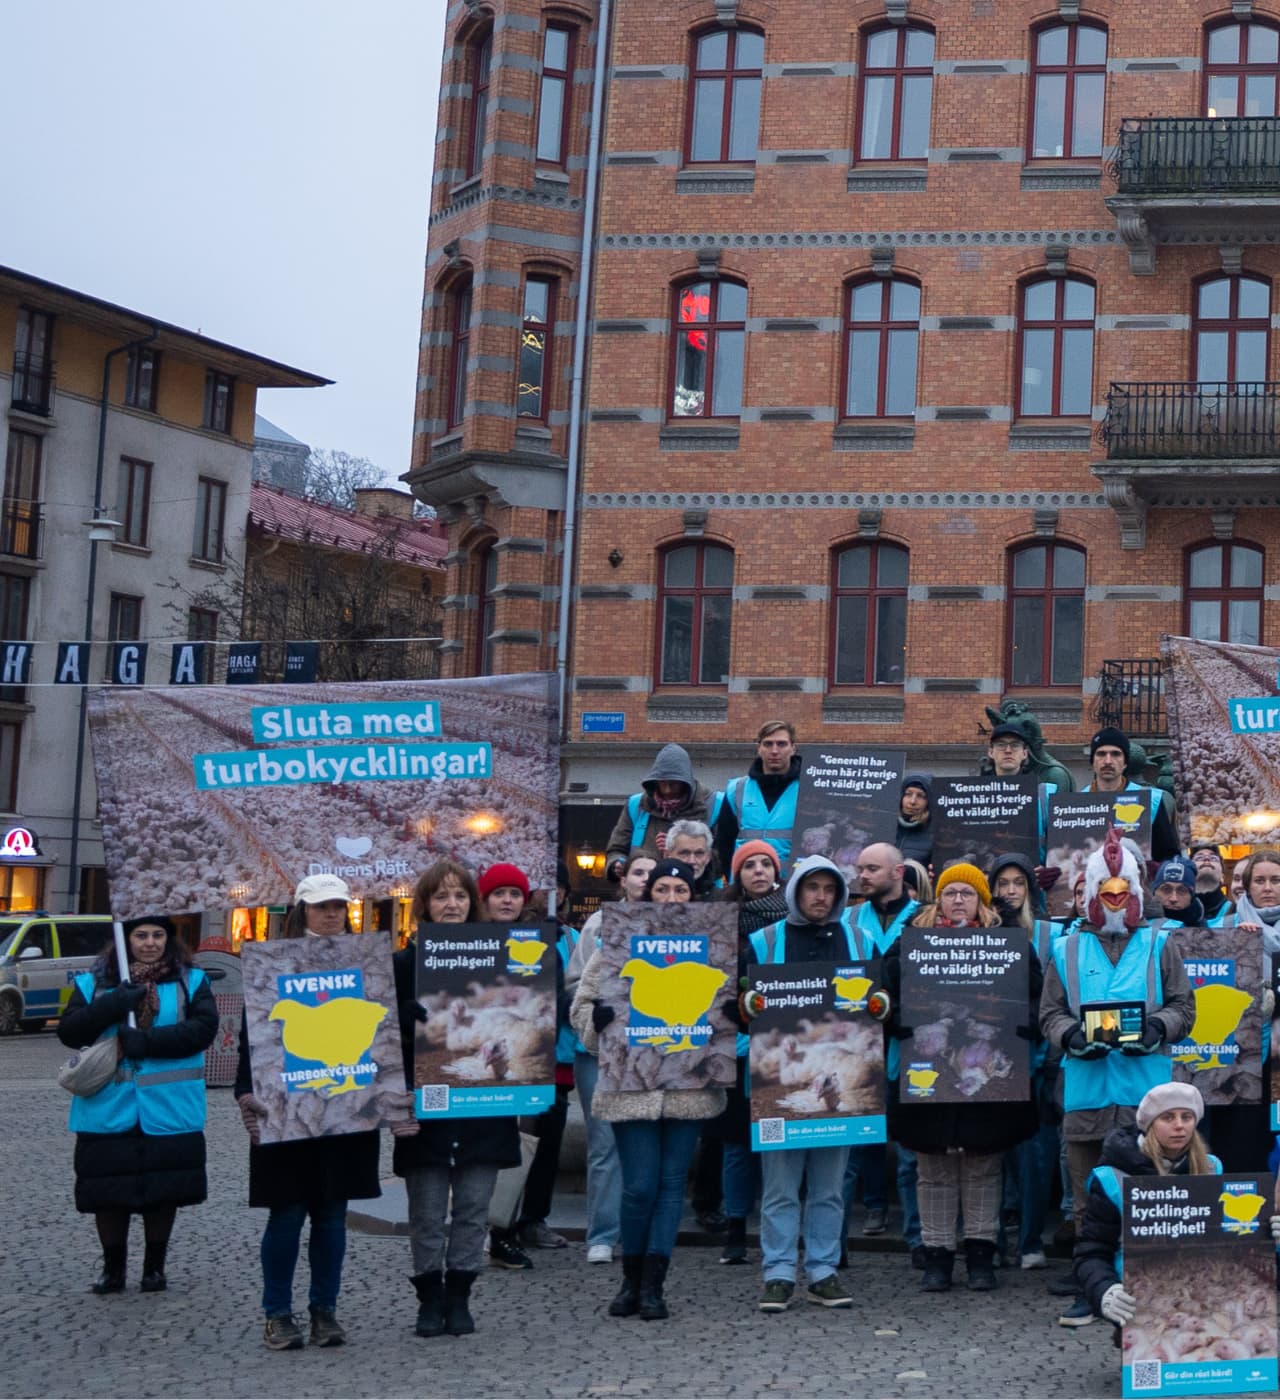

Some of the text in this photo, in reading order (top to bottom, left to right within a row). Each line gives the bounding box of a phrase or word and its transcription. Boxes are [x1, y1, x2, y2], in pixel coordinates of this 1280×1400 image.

[262, 704, 434, 739] Sluta med
[203, 747, 486, 785] turbokycklingar!
[870, 758, 887, 766] har
[806, 767, 838, 780] djuren
[839, 768, 857, 780] här
[862, 769, 897, 780] Sverige
[814, 779, 830, 787] det
[831, 779, 864, 791] väldigt
[1003, 782, 1020, 791] har
[938, 796, 971, 807] djuren
[972, 795, 990, 804] här
[996, 794, 1032, 805] Sverige
[947, 808, 964, 817] det
[966, 807, 999, 817] väldigt
[1054, 804, 1109, 816] Systematiskt
[1053, 817, 1105, 828] djurplågeri!
[376, 859, 414, 876] Rätt.
[425, 939, 500, 952] Systematiskt
[638, 940, 702, 954] SVENSK
[986, 935, 1007, 946] har
[909, 949, 948, 962] djuren
[950, 949, 971, 960] här
[979, 950, 1021, 962] Sverige
[425, 956, 494, 969] djurplågeri!
[920, 964, 939, 975] det
[942, 964, 982, 977] väldigt
[284, 974, 356, 993] SVENSK
[755, 978, 827, 993] Systematiskt
[764, 994, 822, 1008] jurplågeri!
[624, 1025, 712, 1036] TURBOKYCKLING
[280, 1062, 378, 1083] TURBOKYCKLING
[1132, 1186, 1188, 1200] Svenska
[1132, 1204, 1210, 1220] kycklingars
[1132, 1222, 1205, 1237] verklighet!
